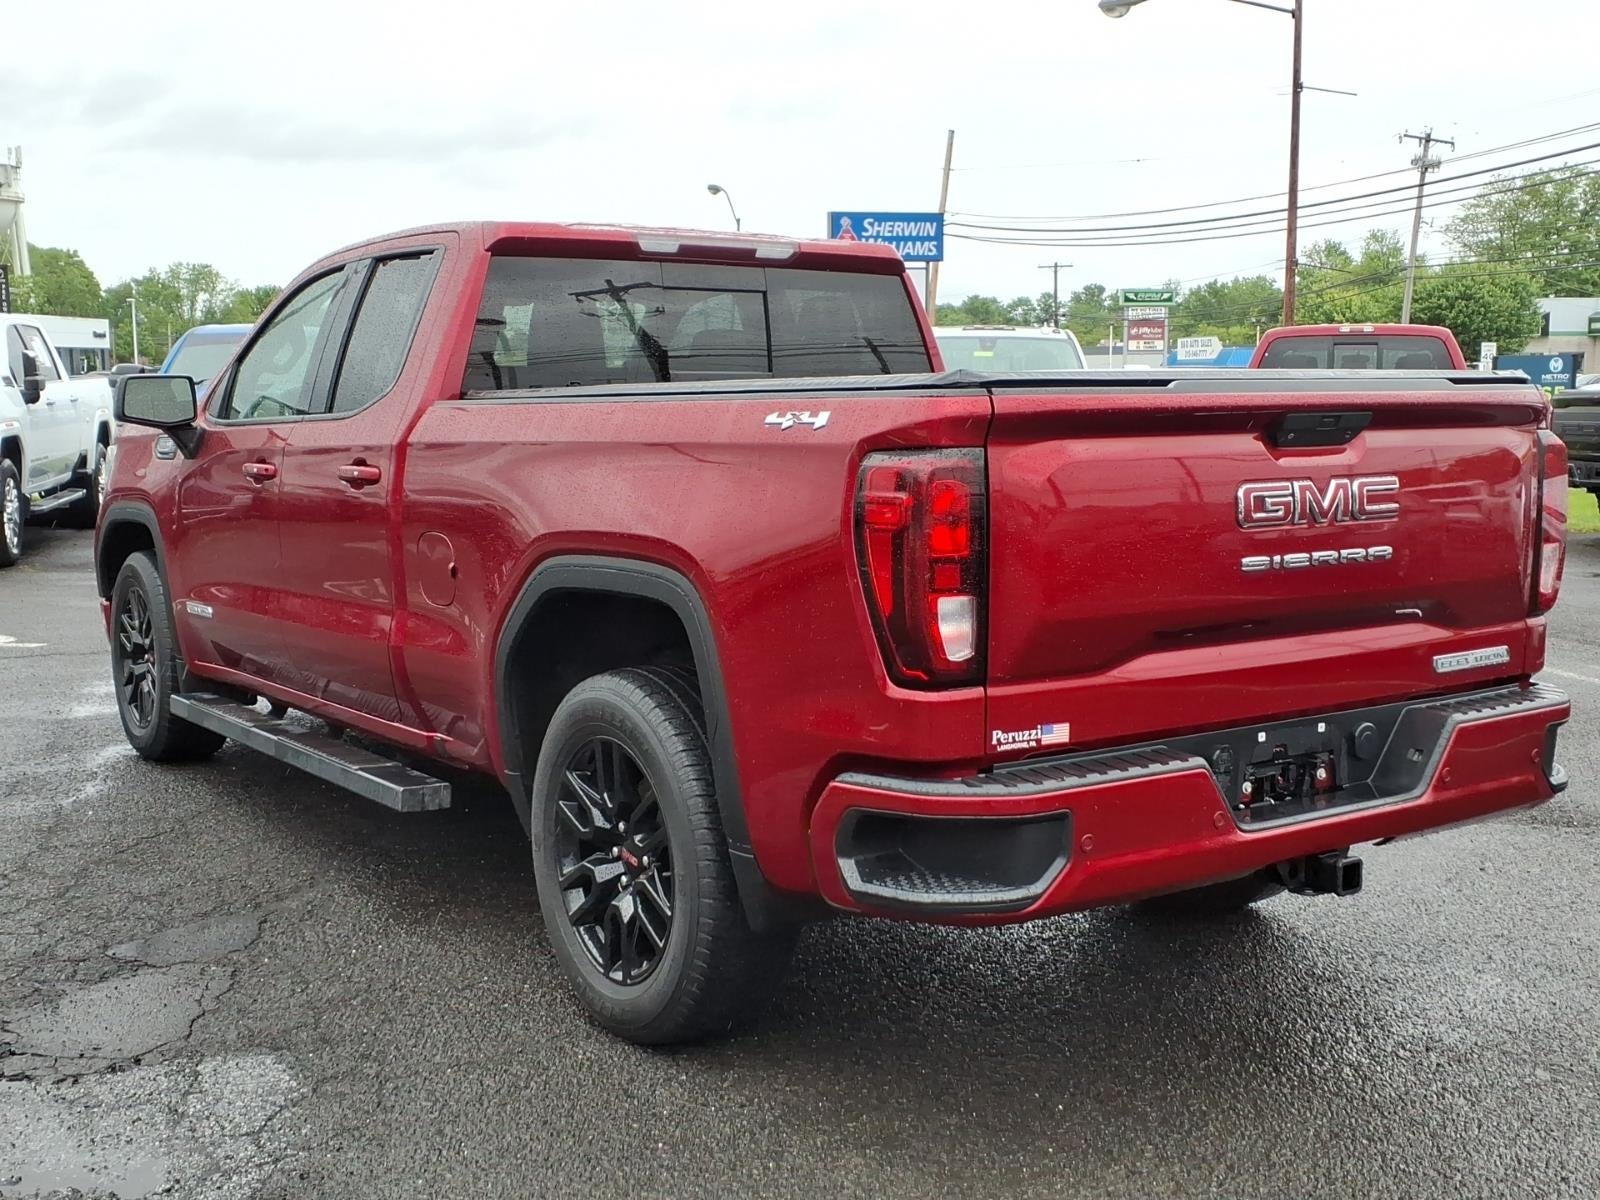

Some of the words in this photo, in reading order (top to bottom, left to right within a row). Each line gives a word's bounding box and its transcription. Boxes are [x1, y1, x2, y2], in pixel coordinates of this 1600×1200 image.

[861, 218, 937, 237] SHERWIN
[861, 238, 938, 256] IAMS
[1482, 352, 1494, 361] 40
[1236, 475, 1400, 529] GMC
[1241, 545, 1393, 572] SIERRA
[991, 724, 1042, 745] Peruzzi
